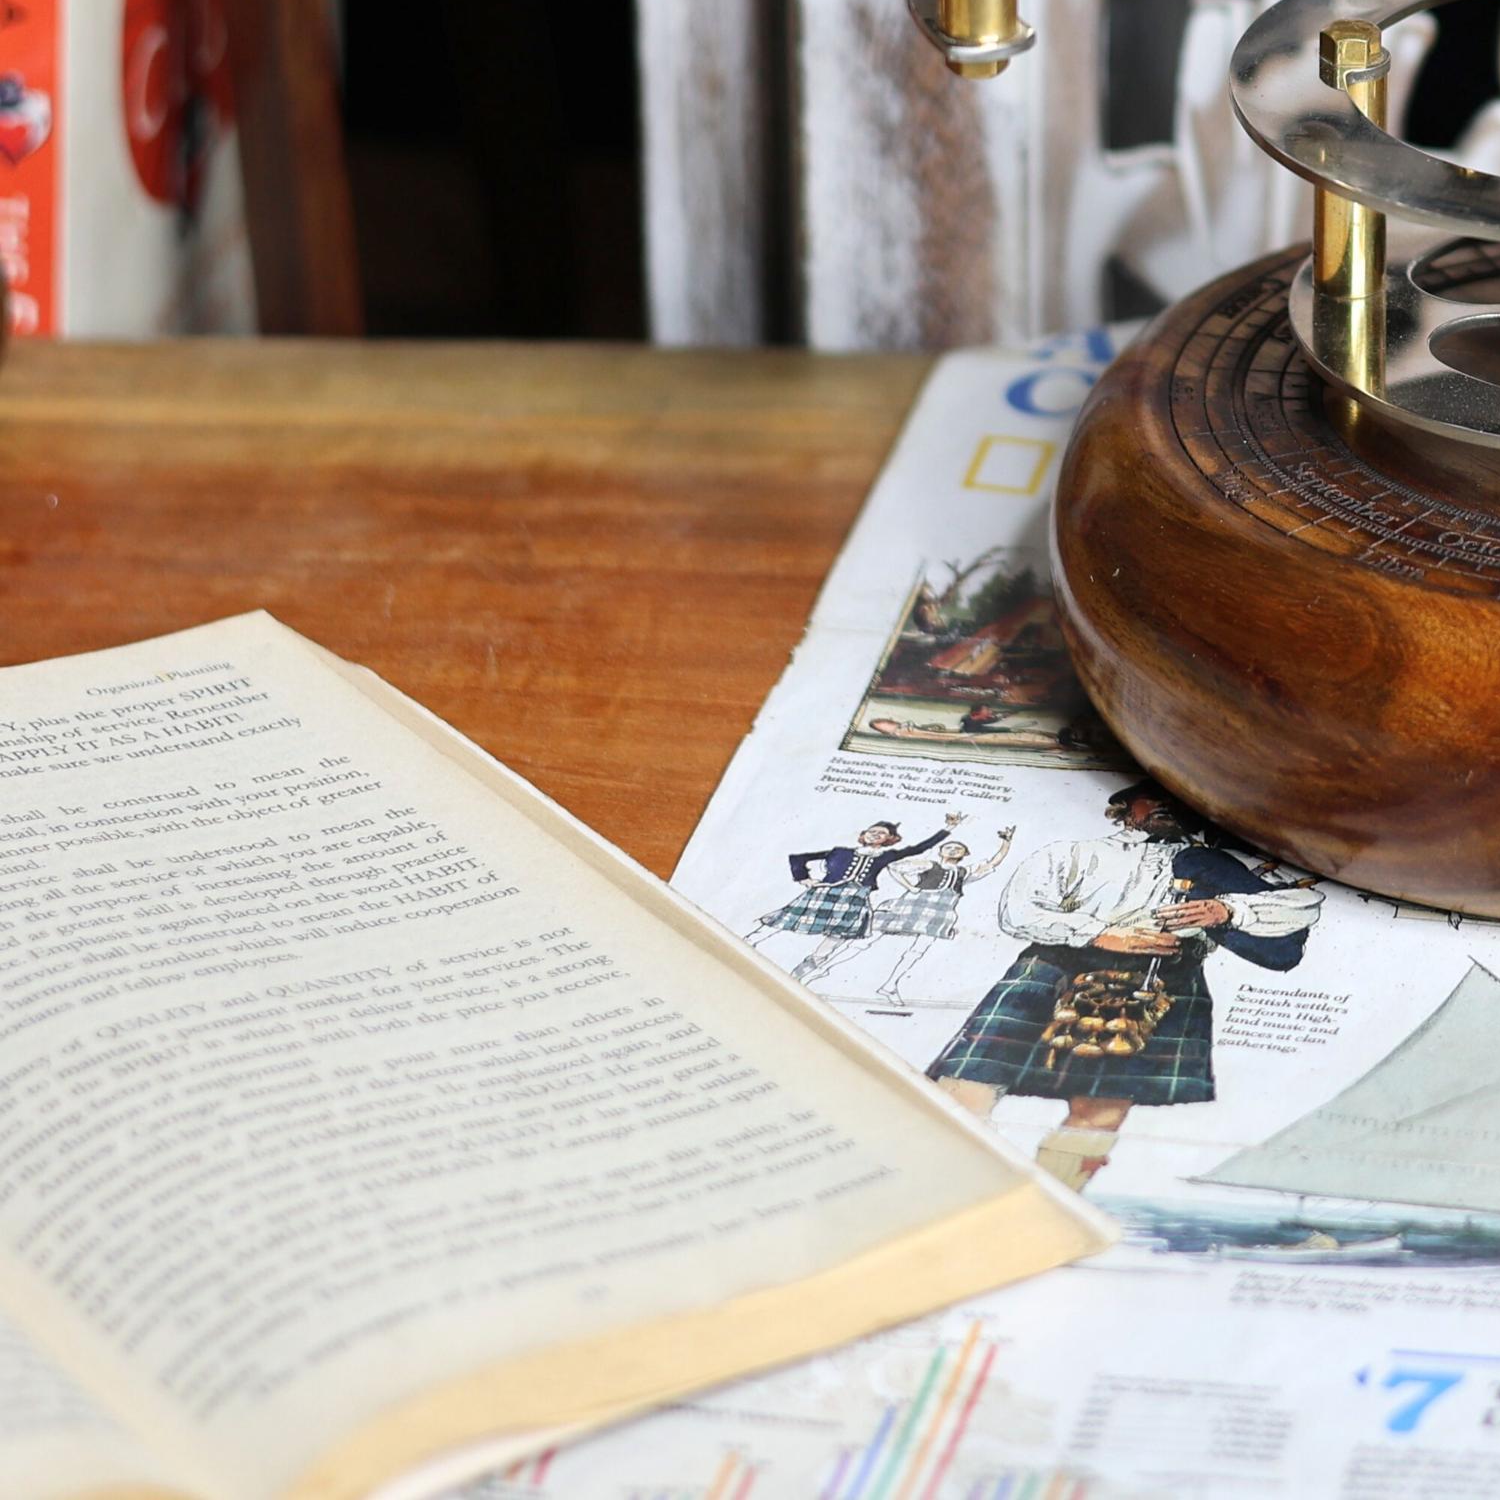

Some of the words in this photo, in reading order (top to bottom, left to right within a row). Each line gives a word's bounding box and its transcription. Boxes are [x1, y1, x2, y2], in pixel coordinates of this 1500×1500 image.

[1287, 459, 1401, 526] September
[86, 675, 165, 698] Organized
[168, 661, 235, 682] Planning
[30, 715, 69, 732] plus
[74, 710, 108, 722] the
[110, 698, 176, 718] proper
[178, 677, 252, 702] SPIRIT
[62, 726, 84, 738] of
[91, 717, 164, 734] service.
[164, 692, 268, 720] Remember
[48, 760, 92, 770] sure
[92, 754, 124, 764] we
[126, 730, 234, 758] understand
[238, 718, 301, 737] exactly
[824, 766, 877, 776] Indians
[898, 773, 920, 782] the
[925, 776, 954, 785] 19th
[830, 756, 887, 770] Hunting
[891, 764, 928, 773] camp
[932, 768, 946, 777] of
[949, 768, 1003, 782] Micmac
[0, 810, 48, 825] shall
[57, 806, 88, 815] be
[102, 786, 200, 810] construed
[214, 782, 236, 790] to
[252, 768, 306, 784] mean
[318, 756, 351, 768] the
[814, 784, 831, 792] of
[819, 774, 877, 788] Painting
[880, 781, 893, 789] in
[897, 783, 956, 795] National
[960, 789, 1012, 802] Gallery
[1234, 994, 1290, 1008] Scottish
[1295, 1002, 1348, 1014] settlers
[1238, 984, 1329, 1000] Descendants
[1334, 994, 1352, 1003] of
[1225, 1014, 1260, 1026] land
[1263, 1021, 1306, 1031] music
[1309, 1027, 1340, 1035] and
[1229, 1006, 1291, 1019] perform
[1222, 1026, 1272, 1039] dances
[1295, 1035, 1327, 1044] clan
[1382, 1370, 1464, 1432] 7
